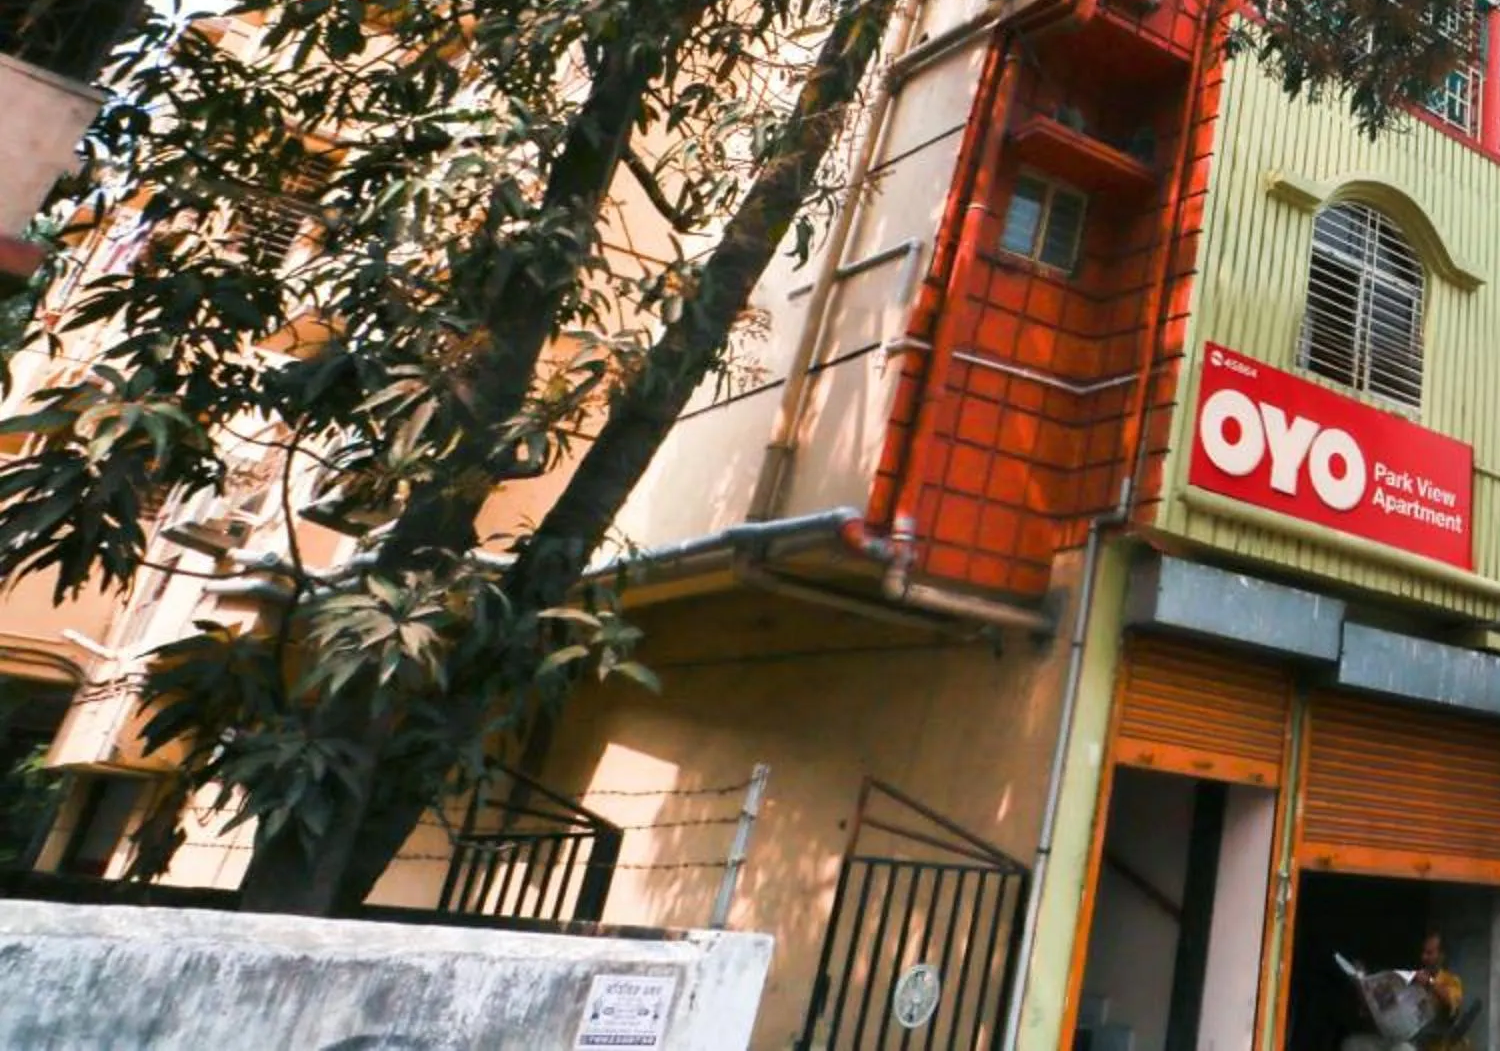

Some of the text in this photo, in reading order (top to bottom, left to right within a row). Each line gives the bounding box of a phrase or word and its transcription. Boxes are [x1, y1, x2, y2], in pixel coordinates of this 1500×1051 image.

[1200, 388, 1367, 512] OYO
[1373, 462, 1457, 508] Park View
[1371, 488, 1464, 534] Apartment
